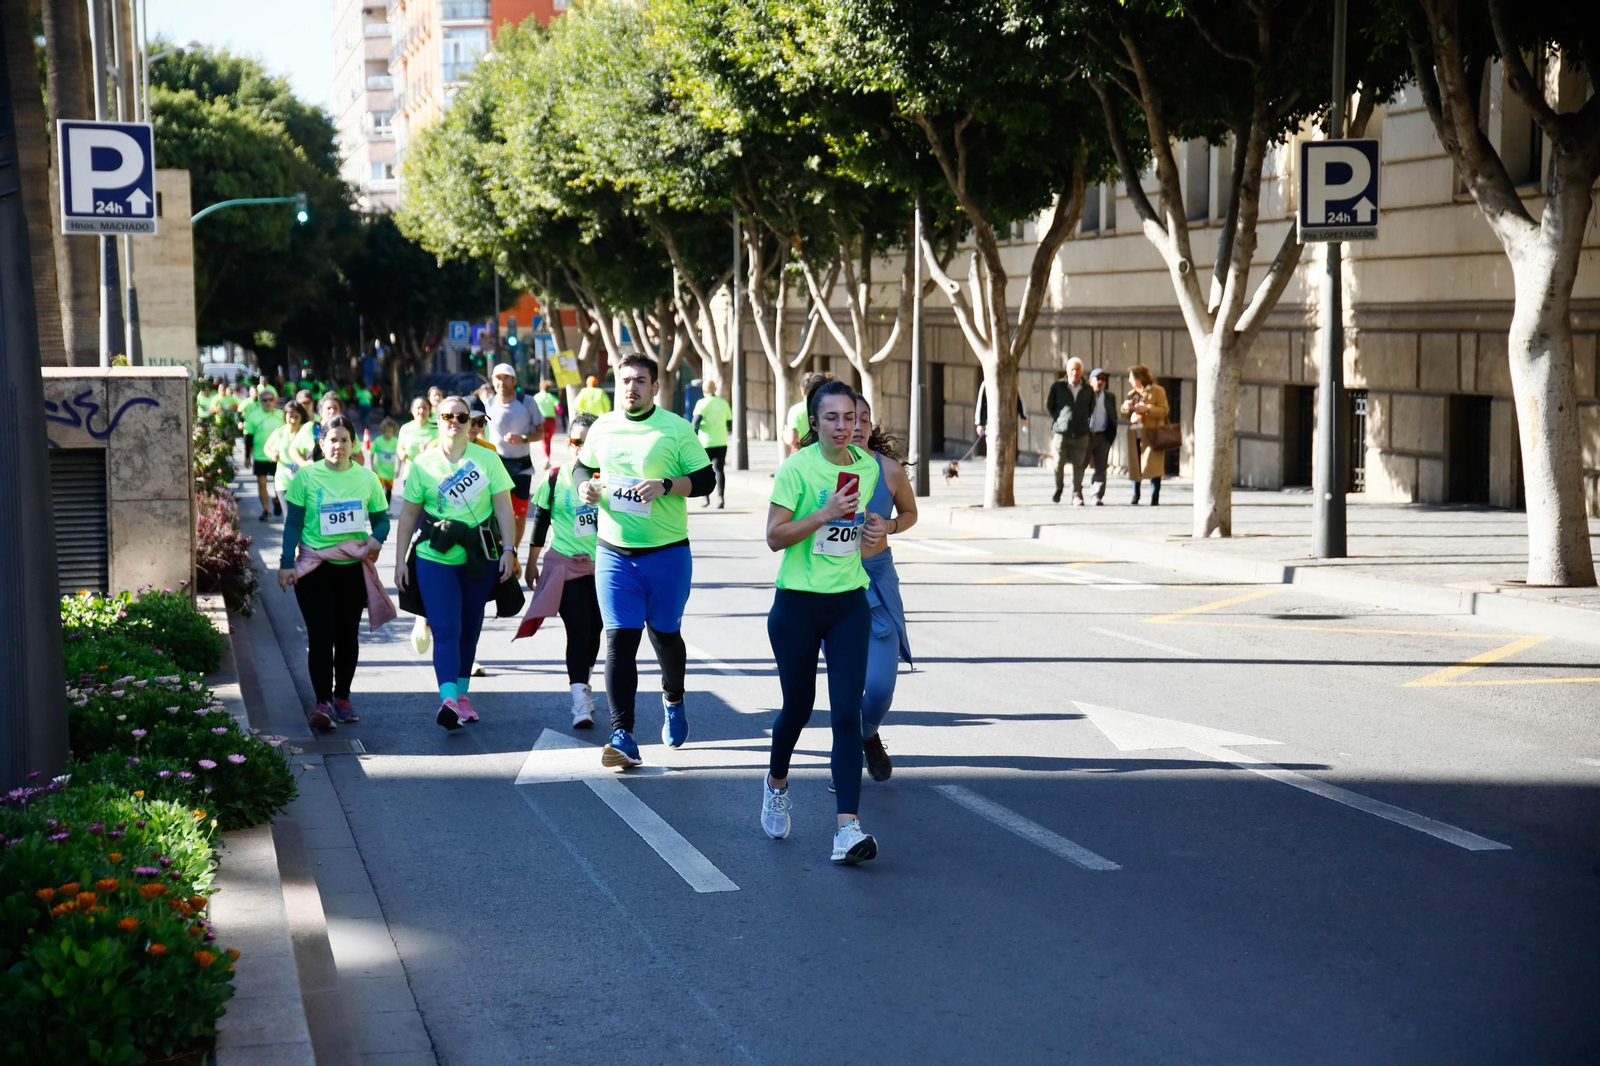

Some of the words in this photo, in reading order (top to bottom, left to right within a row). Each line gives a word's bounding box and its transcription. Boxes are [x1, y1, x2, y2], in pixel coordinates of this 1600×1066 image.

[68, 127, 145, 214] P
[1307, 146, 1372, 224] P
[95, 200, 123, 214] 24h
[1327, 211, 1351, 224] 24h
[70, 221, 96, 230] Hnos.
[100, 222, 149, 231] MACHADO
[1345, 230, 1375, 238] FALCÓN
[448, 470, 480, 498] 1009
[328, 510, 355, 525] 981
[826, 526, 858, 543] 206
